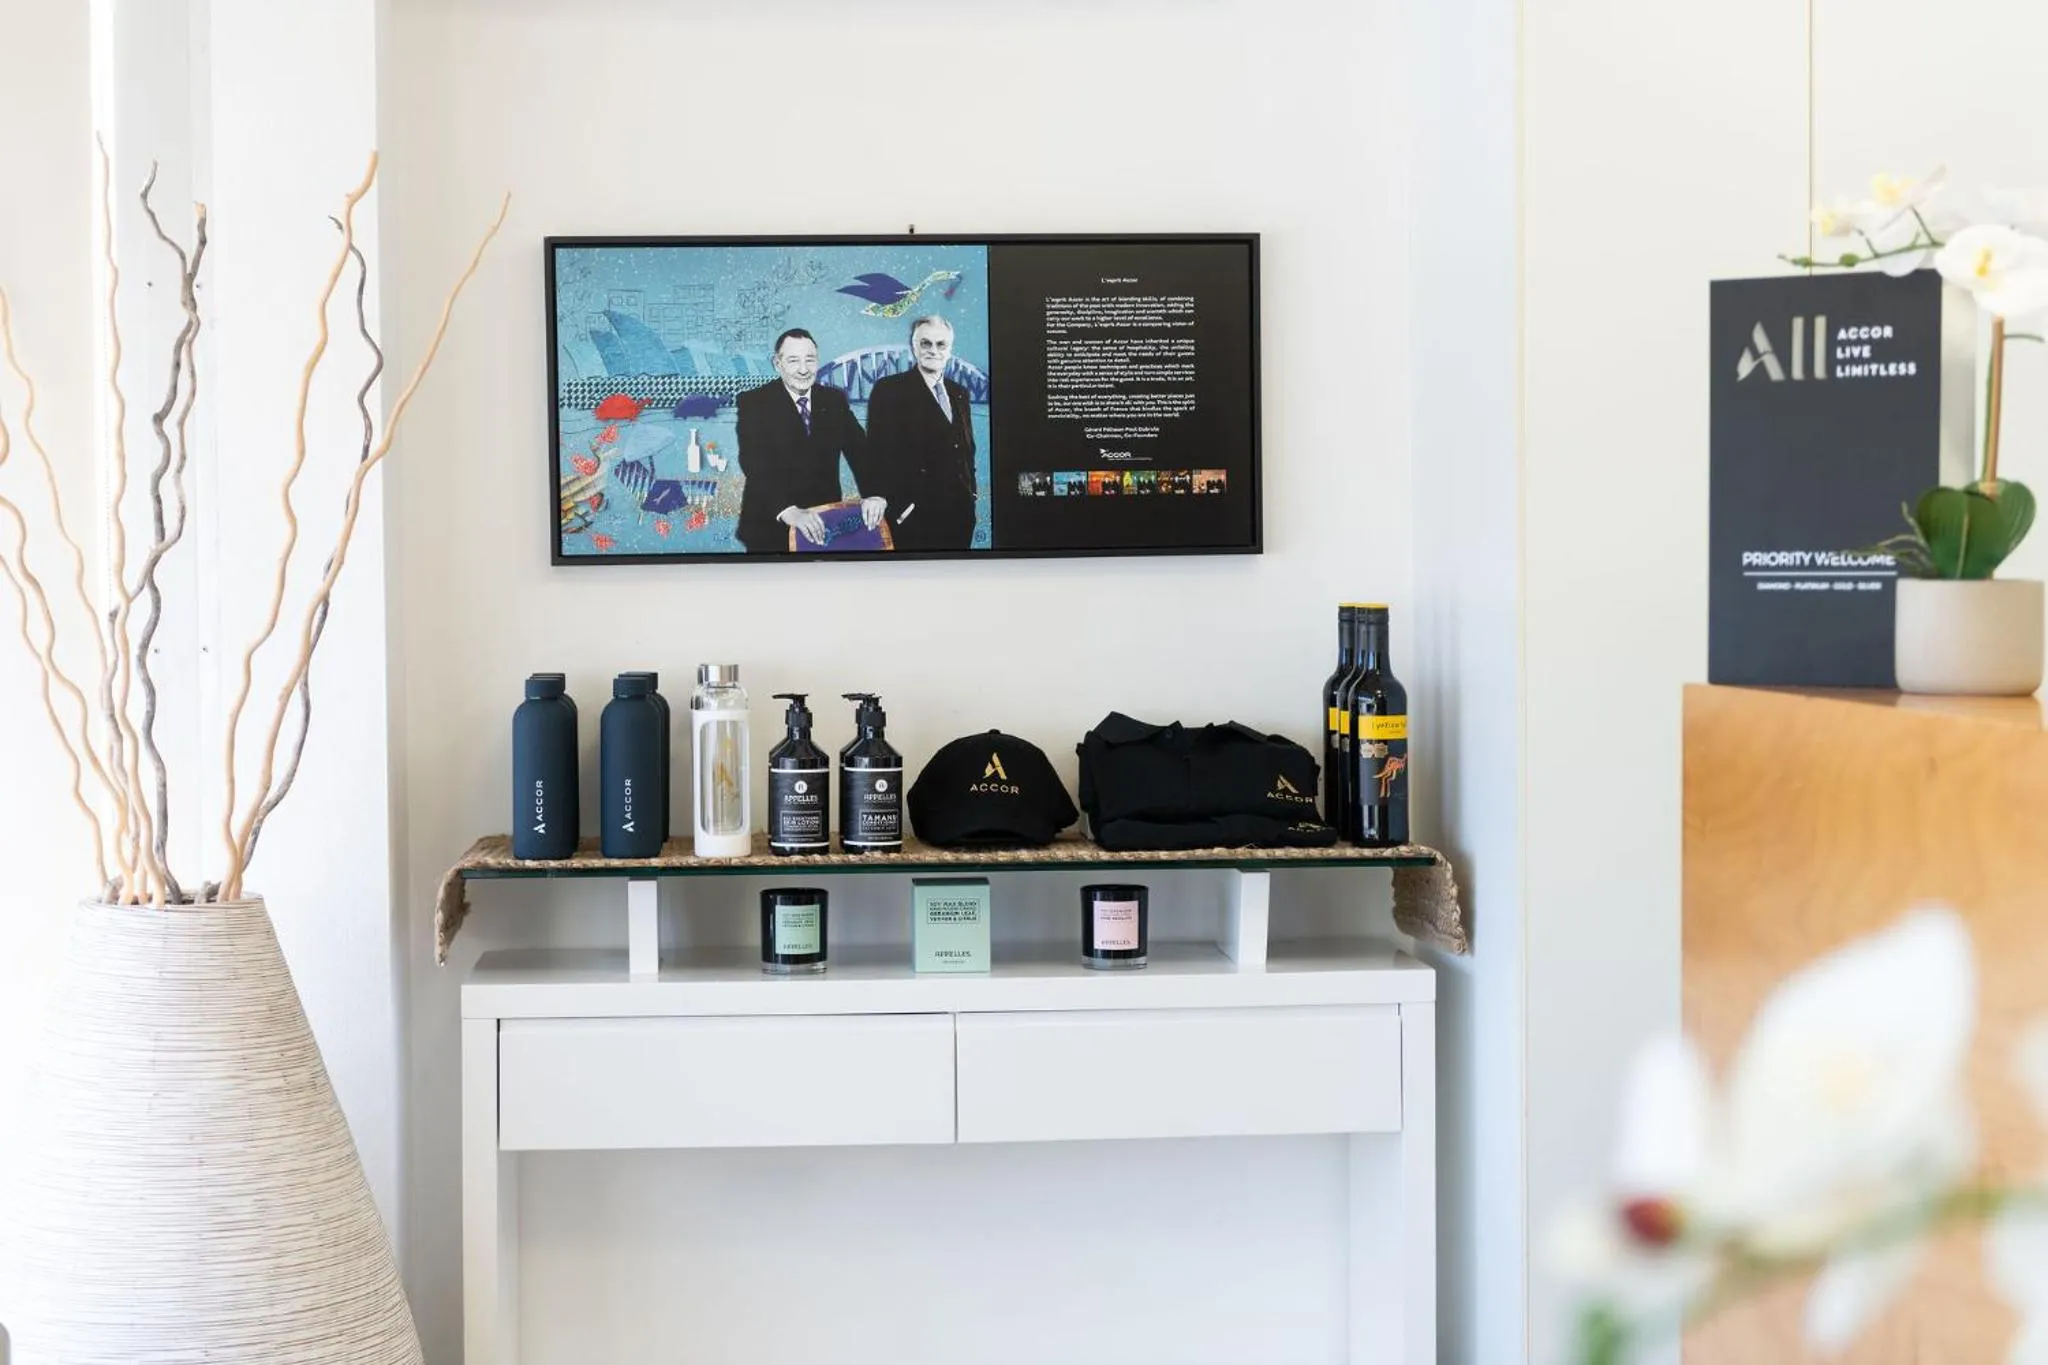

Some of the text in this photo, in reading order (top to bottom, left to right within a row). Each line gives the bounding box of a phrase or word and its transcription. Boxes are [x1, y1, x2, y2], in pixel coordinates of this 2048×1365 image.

[1837, 325, 1893, 341] ACCOR
[1836, 345, 1871, 359] LIVE
[1836, 362, 1916, 378] LIMITLESS
[1742, 551, 1813, 567] PRIORITY
[970, 782, 1020, 794] ACCOR
[536, 780, 544, 822] ACCOR
[1266, 792, 1313, 804] ACCOR
